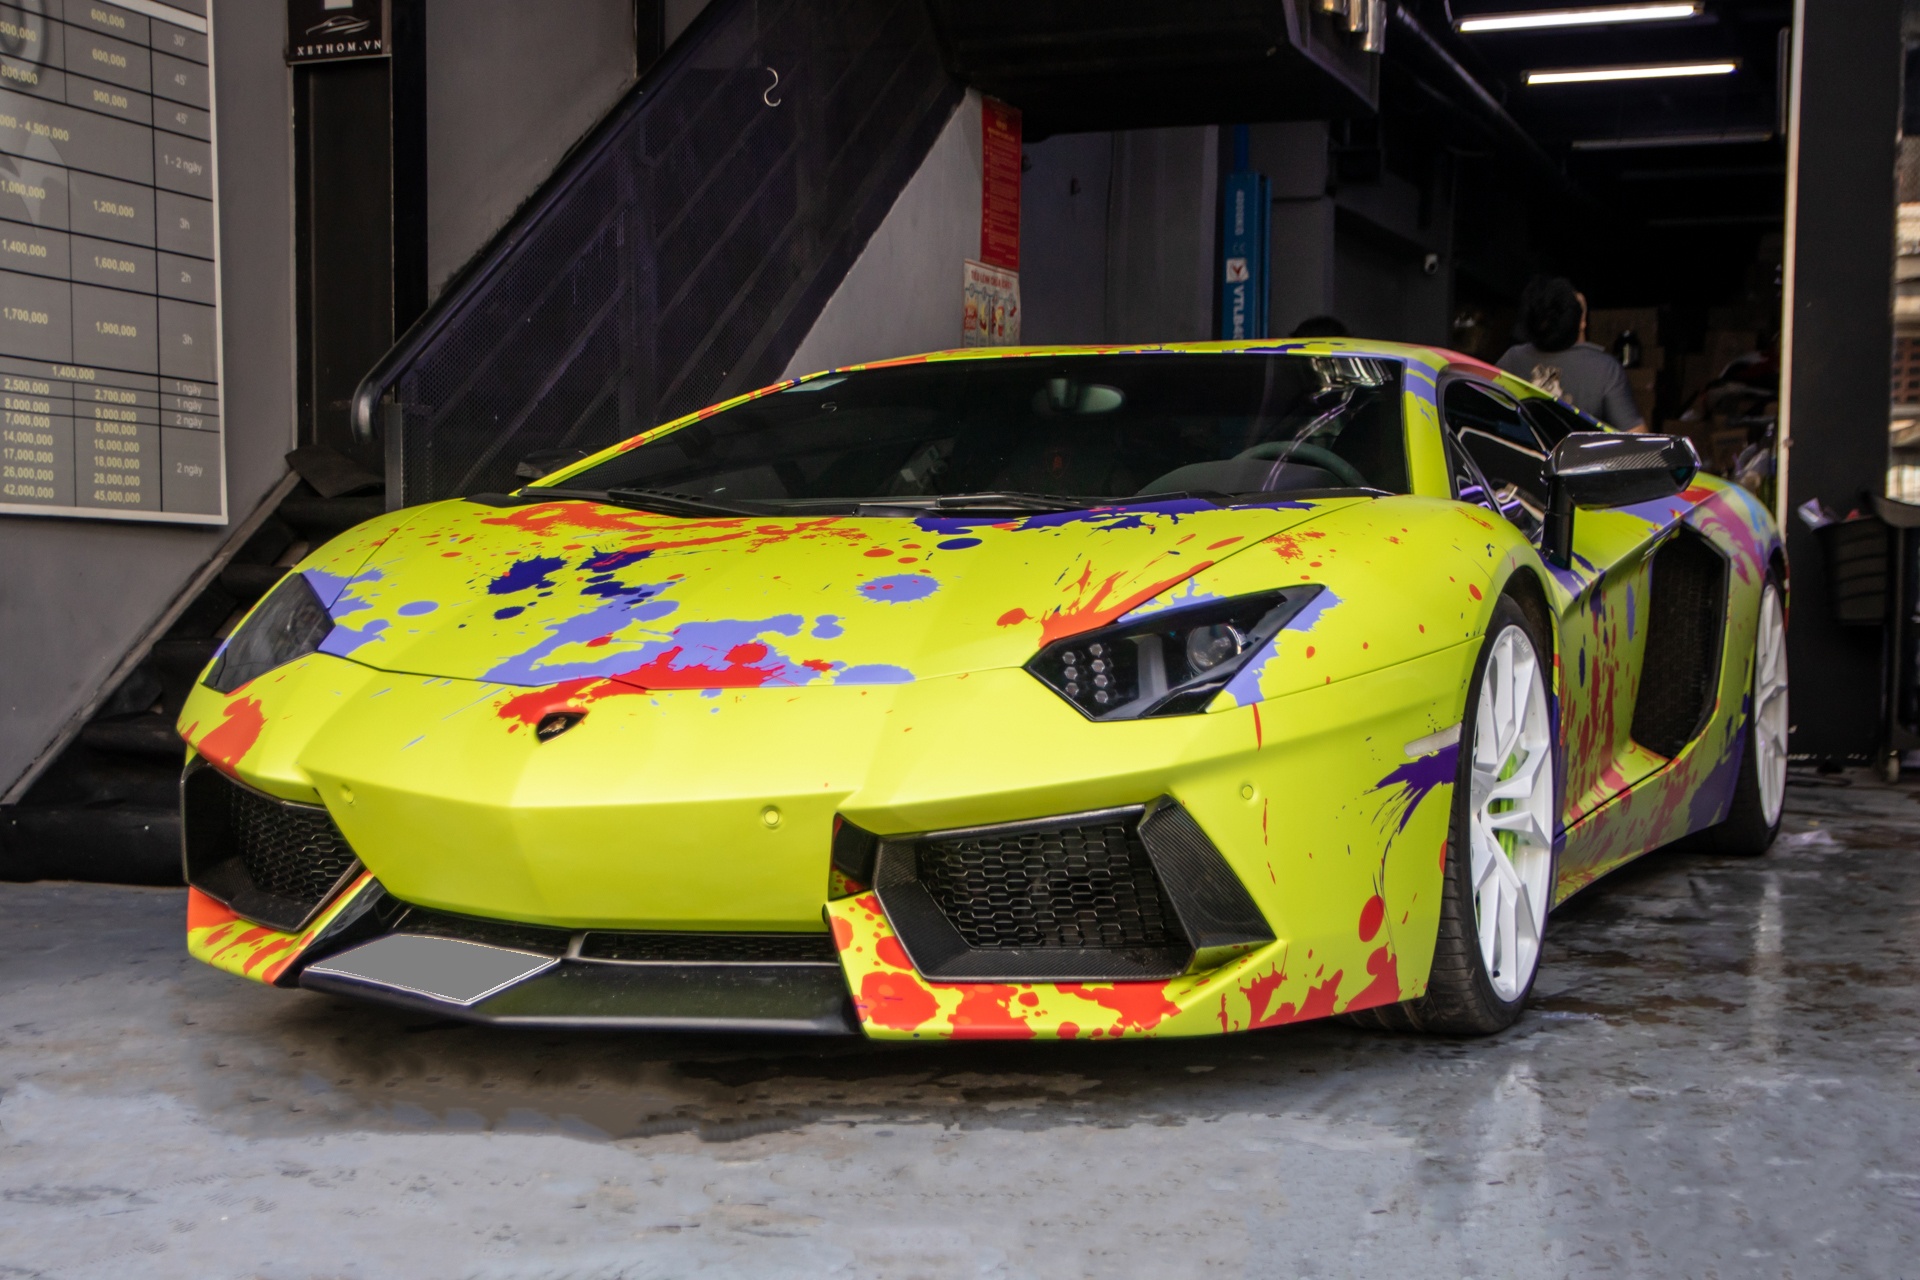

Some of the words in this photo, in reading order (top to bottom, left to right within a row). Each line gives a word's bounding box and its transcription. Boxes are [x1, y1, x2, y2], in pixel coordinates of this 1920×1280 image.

[297, 40, 382, 56] XETHOM.VN
[176, 157, 182, 168] 2
[1, 180, 46, 200] 1,000,000
[93, 200, 134, 218] 1,200,000
[180, 218, 190, 230] 3h
[2, 239, 46, 258] 1,400,000
[94, 256, 135, 273] 1,600,000
[181, 272, 191, 284] 2h
[3, 307, 48, 325] 1,700,000
[96, 321, 136, 337] 1,900,000
[182, 334, 192, 346] 3h
[52, 366, 94, 380] 1,400,000
[4, 378, 49, 395] 2,500,000
[5, 412, 50, 428] 7,000,000
[176, 414, 182, 424] 2
[3, 430, 53, 446] 14,000,000
[94, 439, 139, 454] 16,000,000
[3, 448, 53, 464] 17,000,000
[3, 466, 54, 481] 26,000,000
[177, 462, 182, 473] 2
[3, 484, 54, 499] 42,000,000
[94, 490, 140, 503] 45,000,000
